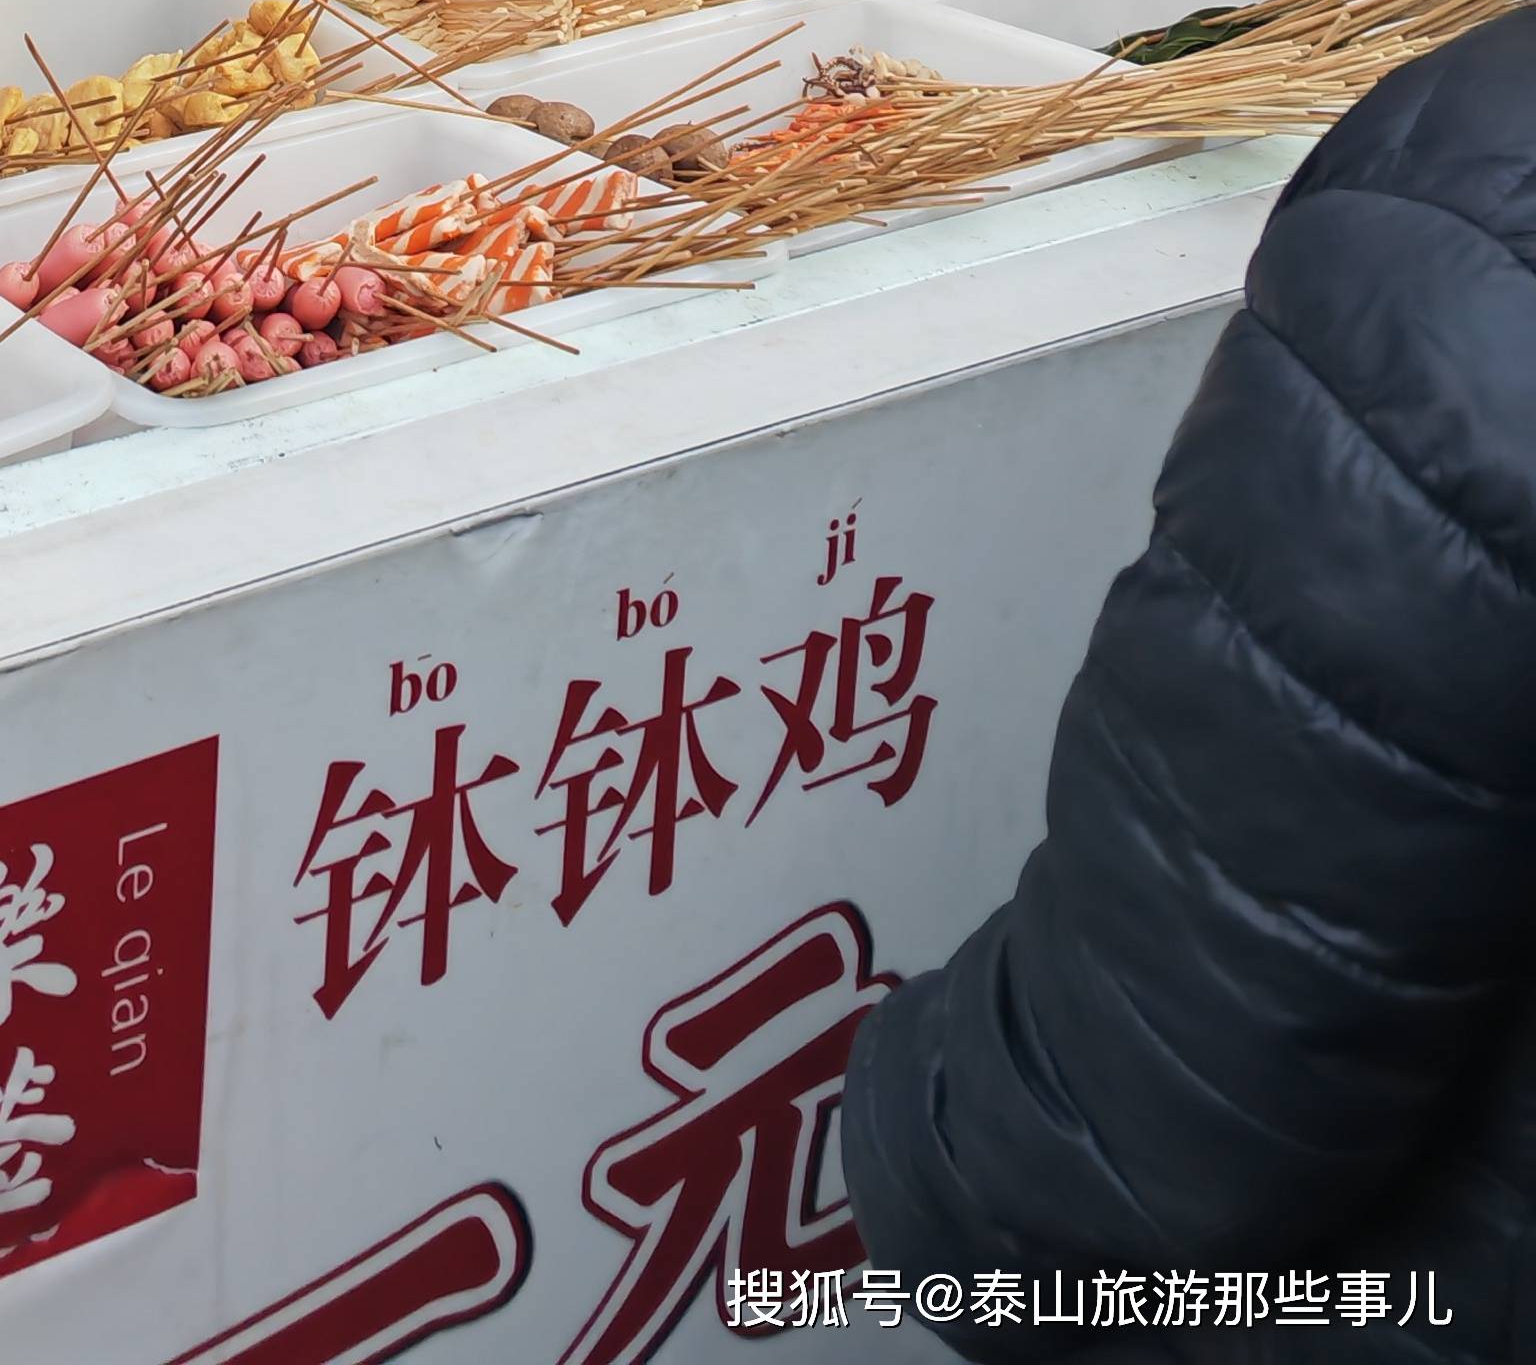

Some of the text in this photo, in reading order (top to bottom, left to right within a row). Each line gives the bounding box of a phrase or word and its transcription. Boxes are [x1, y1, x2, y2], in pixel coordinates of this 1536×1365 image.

[101, 821, 168, 1077] Le qian
[293, 576, 939, 1021] 钵钵鸡
